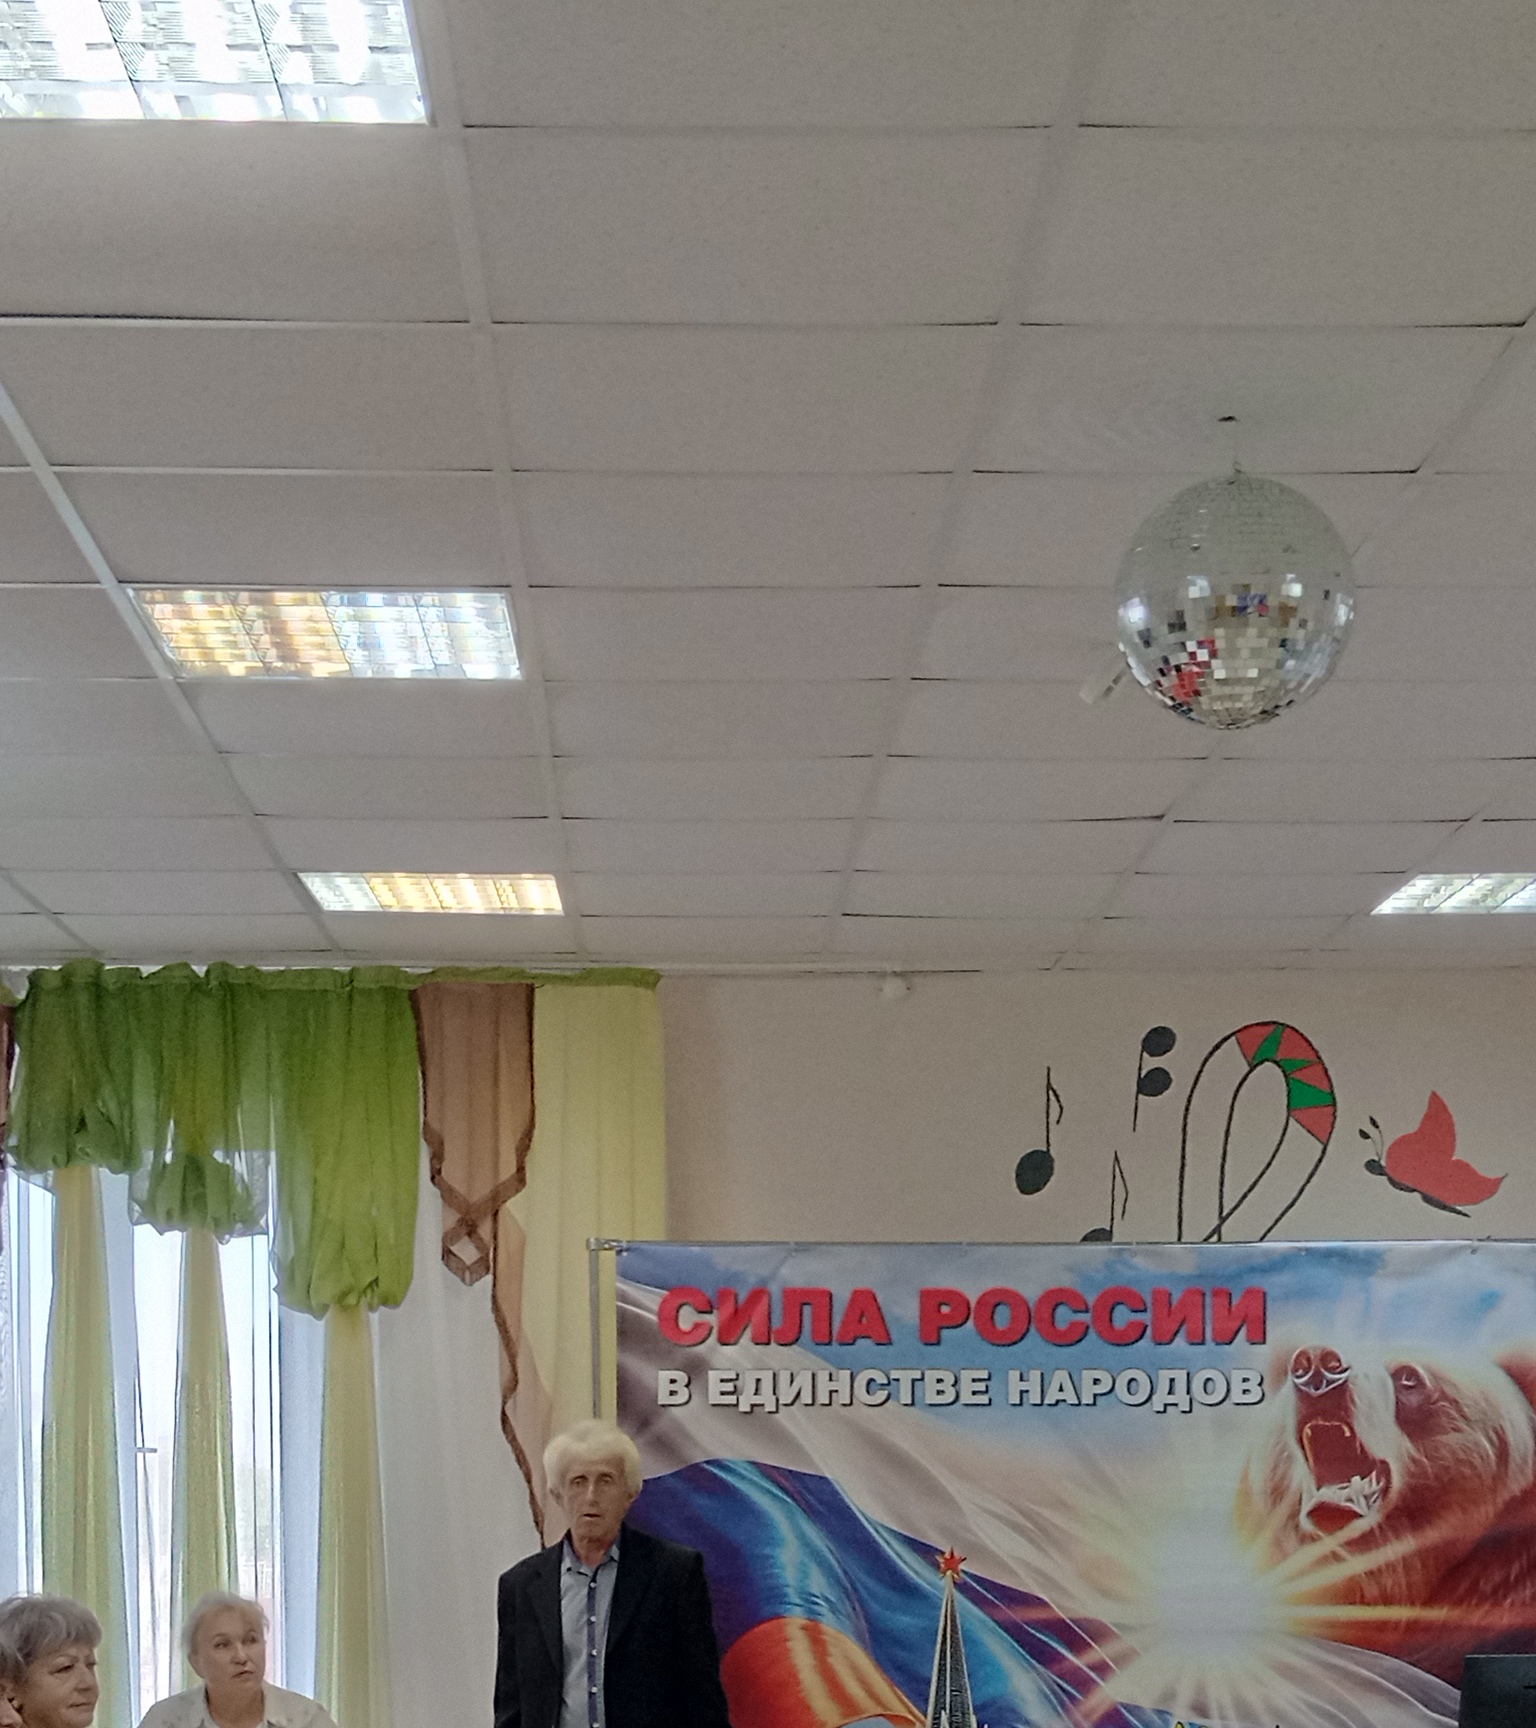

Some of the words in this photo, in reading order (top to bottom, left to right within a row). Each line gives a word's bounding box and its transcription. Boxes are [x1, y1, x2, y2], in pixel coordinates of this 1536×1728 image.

[658, 1286, 893, 1346] СИЛА
[918, 1286, 1267, 1346] РОССИИ
[658, 1369, 692, 1406] В
[707, 1368, 992, 1413] ЕДИНСТВЕ
[1007, 1368, 1266, 1413] НАРОДОВ
